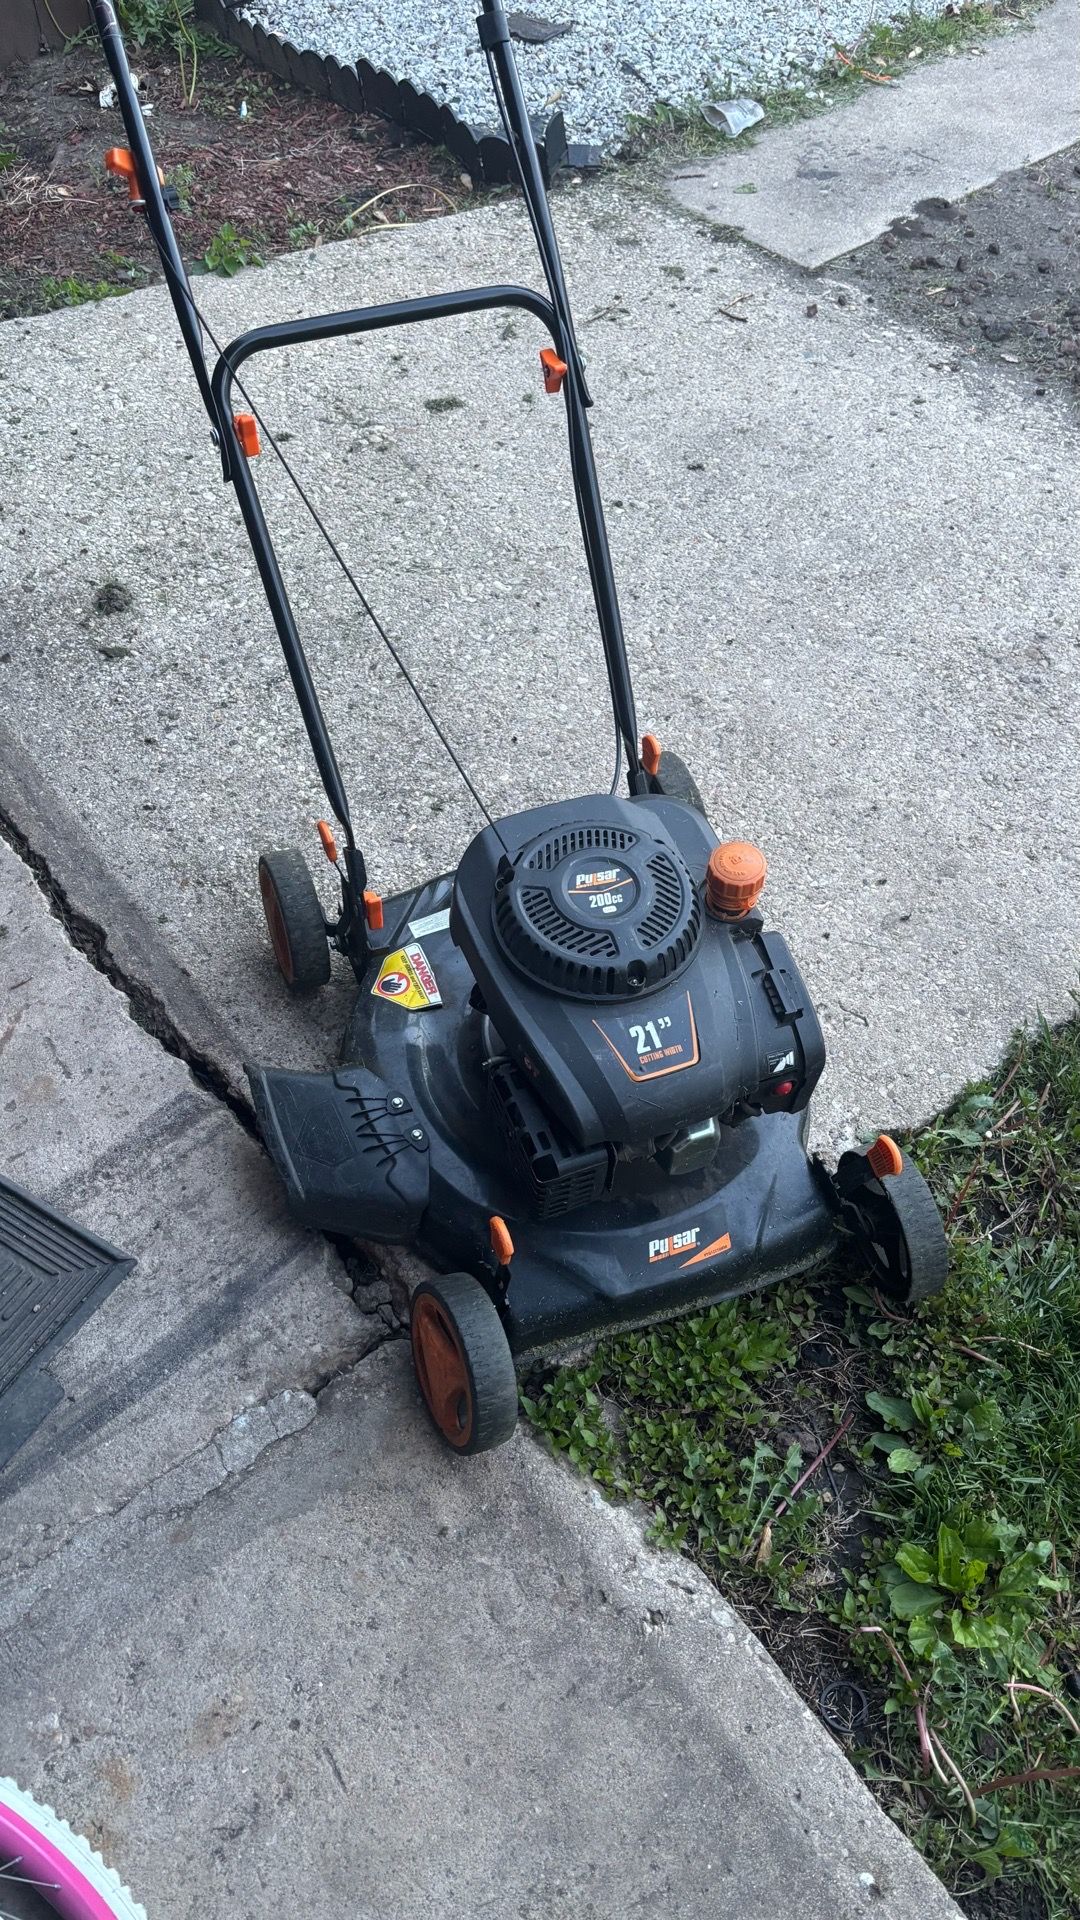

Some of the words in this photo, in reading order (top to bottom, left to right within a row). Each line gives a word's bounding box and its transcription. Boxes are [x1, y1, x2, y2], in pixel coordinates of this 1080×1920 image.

[588, 892, 623, 908] 200cc
[410, 953, 437, 995] DANGER
[639, 1050, 664, 1064] CUTTING
[663, 1044, 683, 1058] WIDTH
